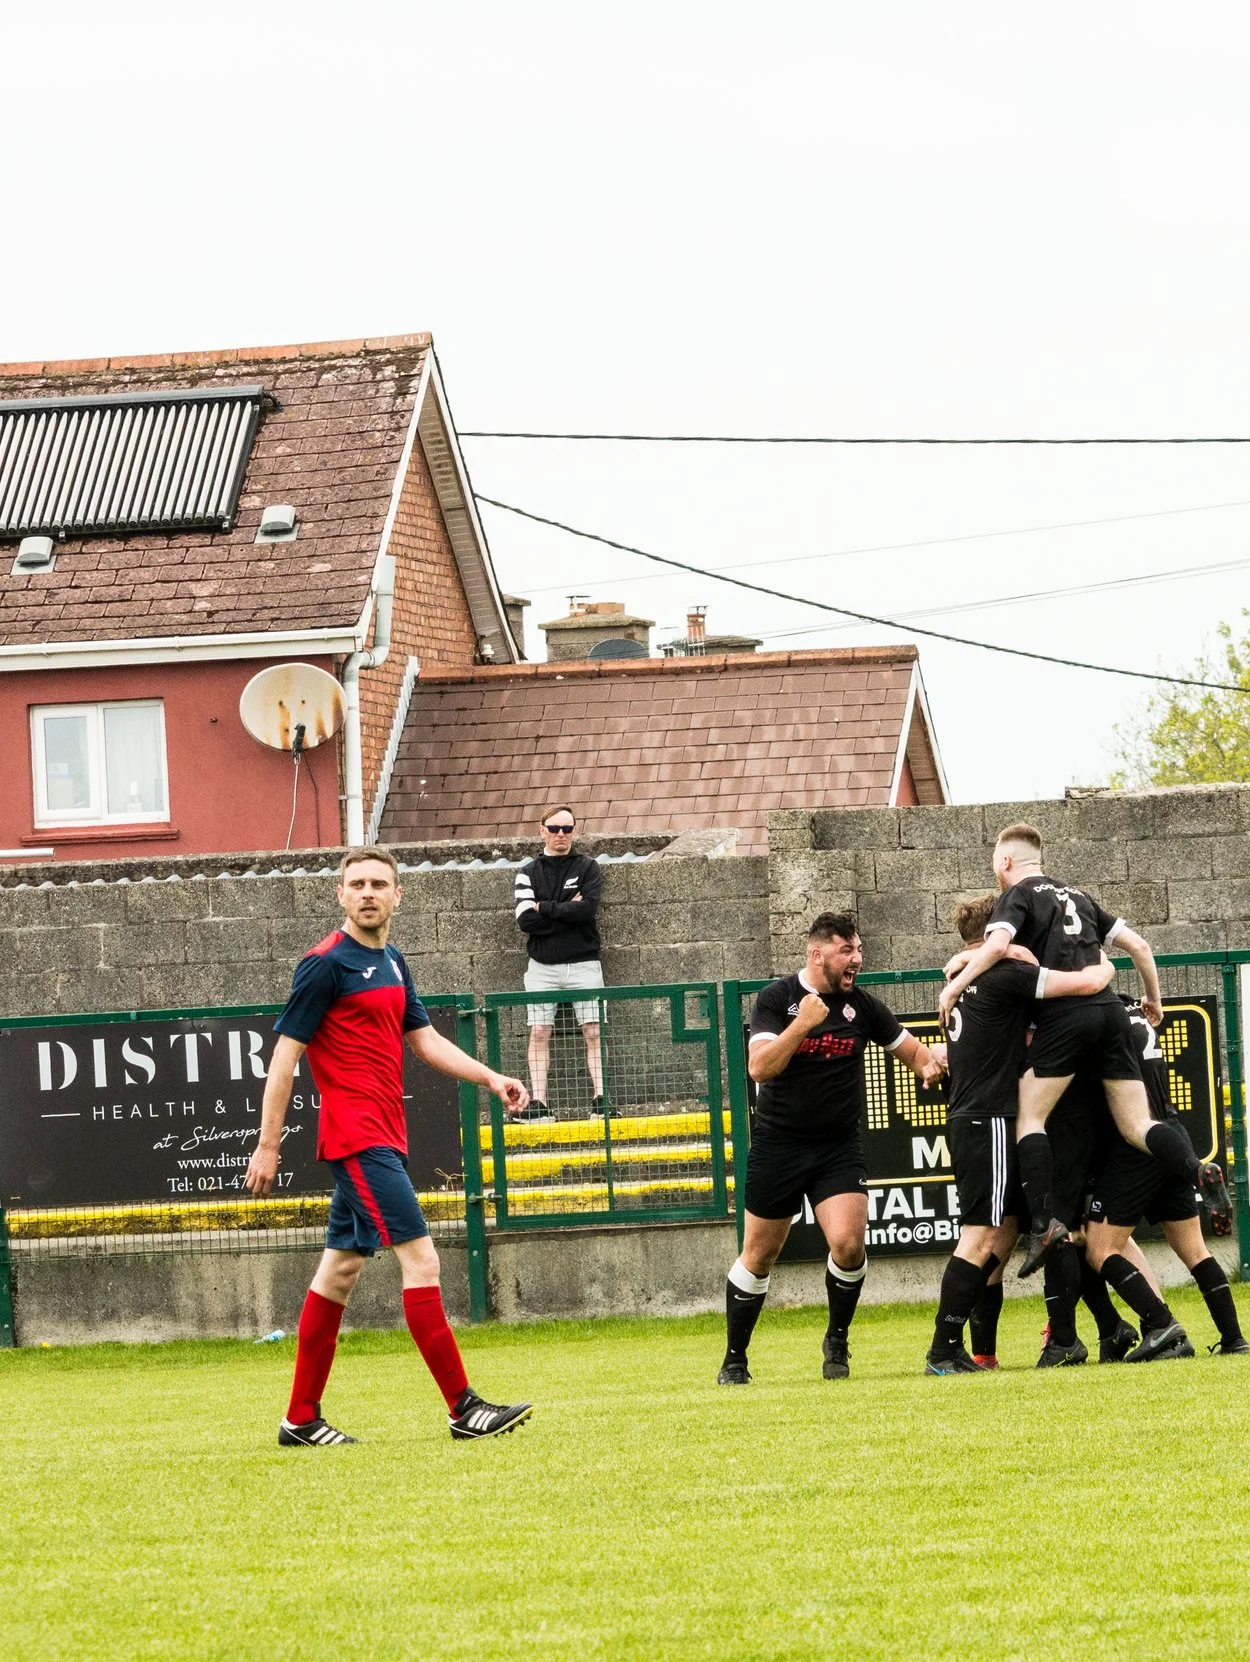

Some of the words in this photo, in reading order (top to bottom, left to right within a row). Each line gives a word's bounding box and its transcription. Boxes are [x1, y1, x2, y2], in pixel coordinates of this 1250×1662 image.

[1056, 893, 1083, 935] 3
[37, 1029, 301, 1091] DISTR
[92, 1100, 195, 1121] HEALTH
[214, 1100, 227, 1114] &
[152, 1133, 179, 1150] at
[180, 1124, 304, 1151] Silversprgs
[167, 1177, 194, 1193] Tel:
[197, 1174, 247, 1192] 021-47
[276, 1172, 294, 1188] 17
[865, 1218, 962, 1246] info@Bi
